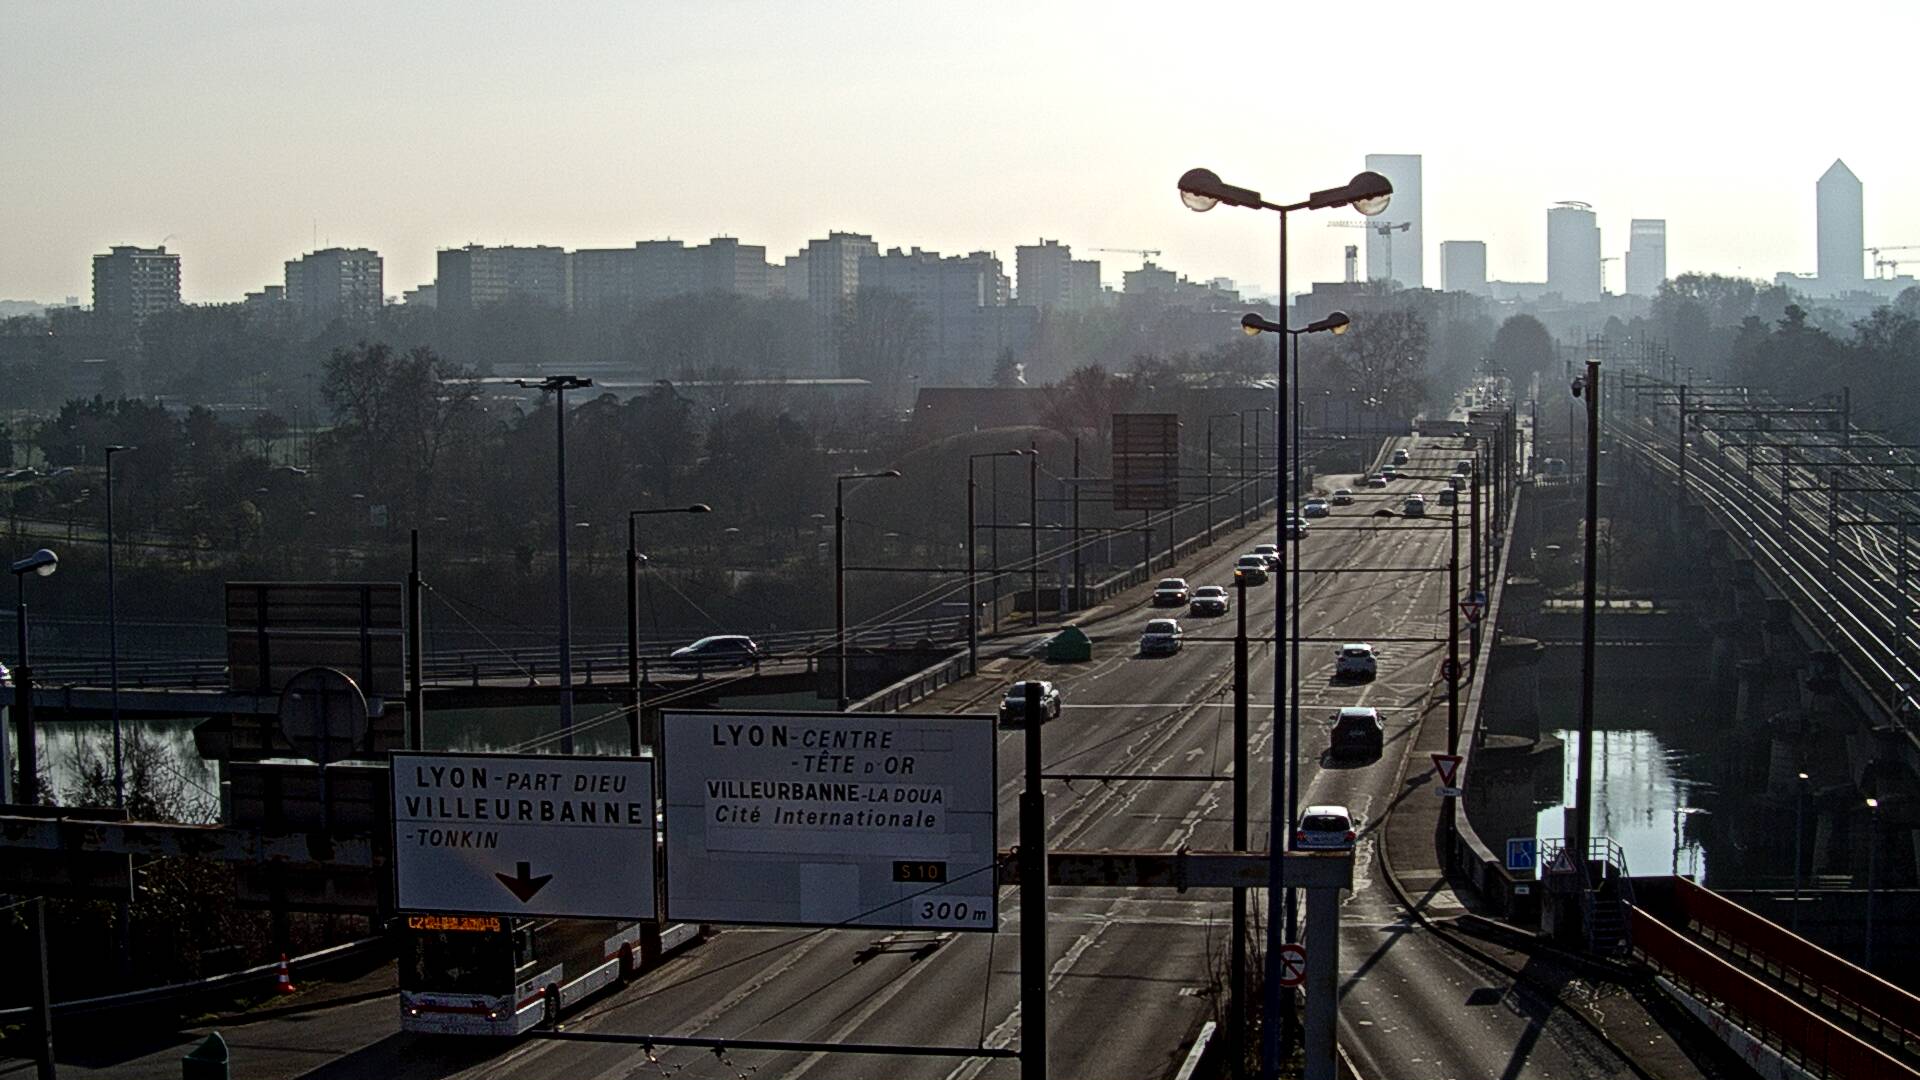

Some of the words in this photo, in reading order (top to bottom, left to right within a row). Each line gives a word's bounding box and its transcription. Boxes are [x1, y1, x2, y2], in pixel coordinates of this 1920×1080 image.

[574, 774, 627, 793] DIEU
[893, 788, 943, 804] DOUA
[405, 796, 642, 824] VILLEURBANNE
[715, 805, 761, 823] Cité
[774, 807, 936, 828] Internationale
[918, 865, 938, 879] 10
[921, 902, 968, 921] 300
[972, 908, 987, 921] m
